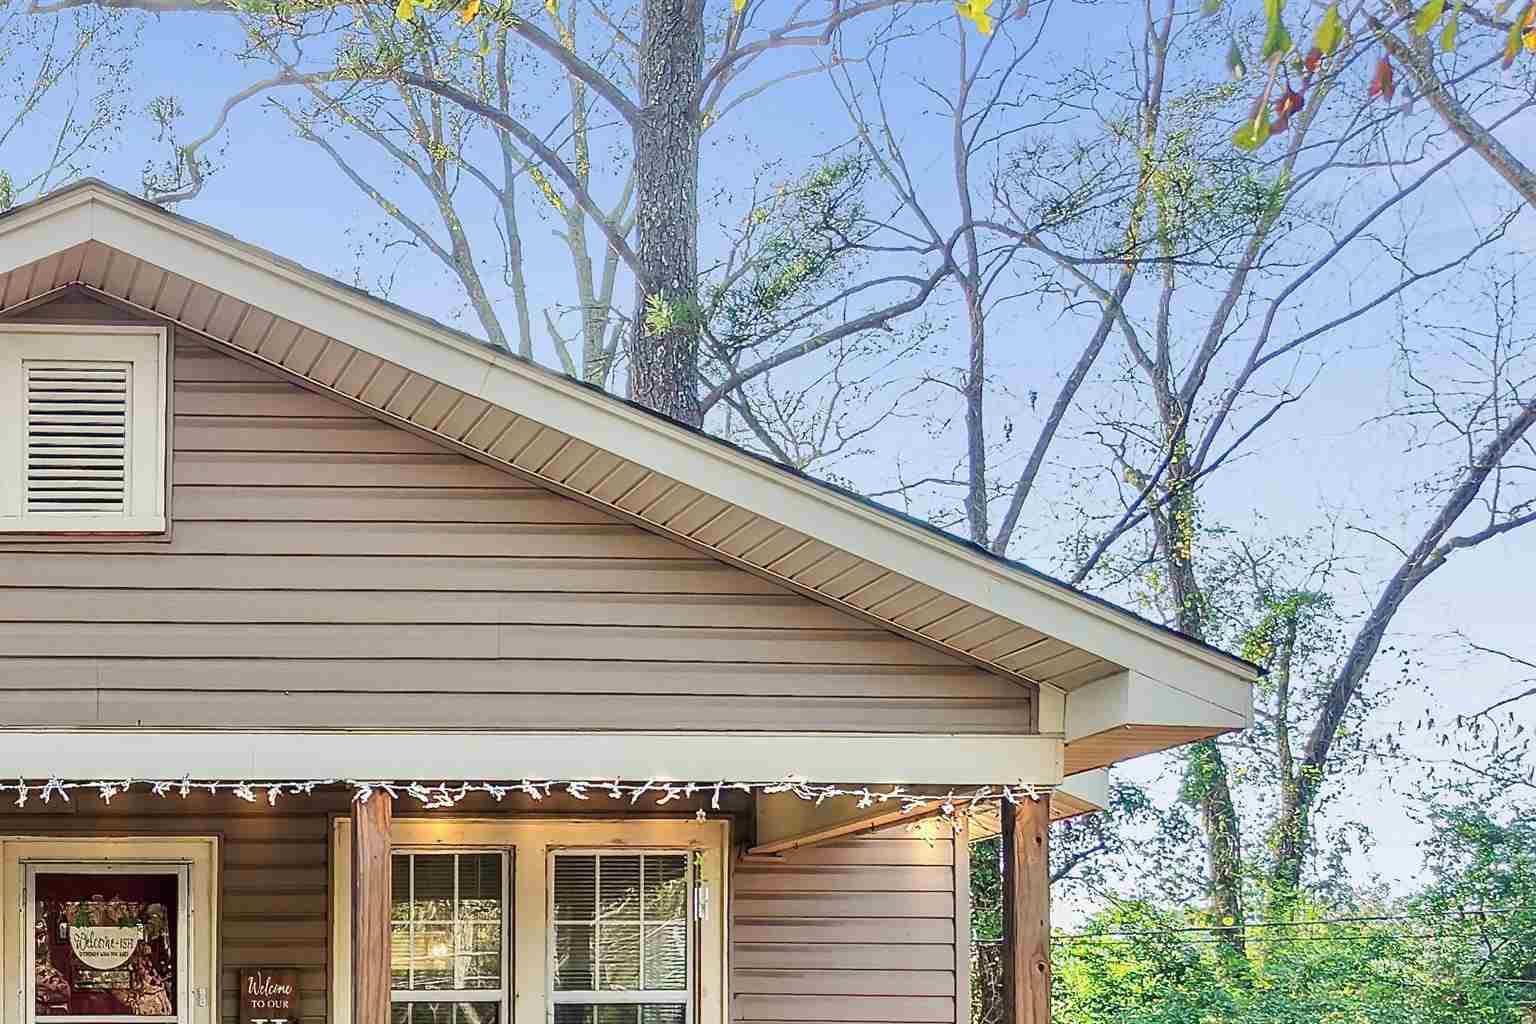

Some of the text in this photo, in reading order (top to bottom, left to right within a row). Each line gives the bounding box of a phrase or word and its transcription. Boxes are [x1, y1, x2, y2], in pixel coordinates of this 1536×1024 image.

[247, 970, 293, 997] Welcome
[251, 999, 289, 1009] TO OUR
